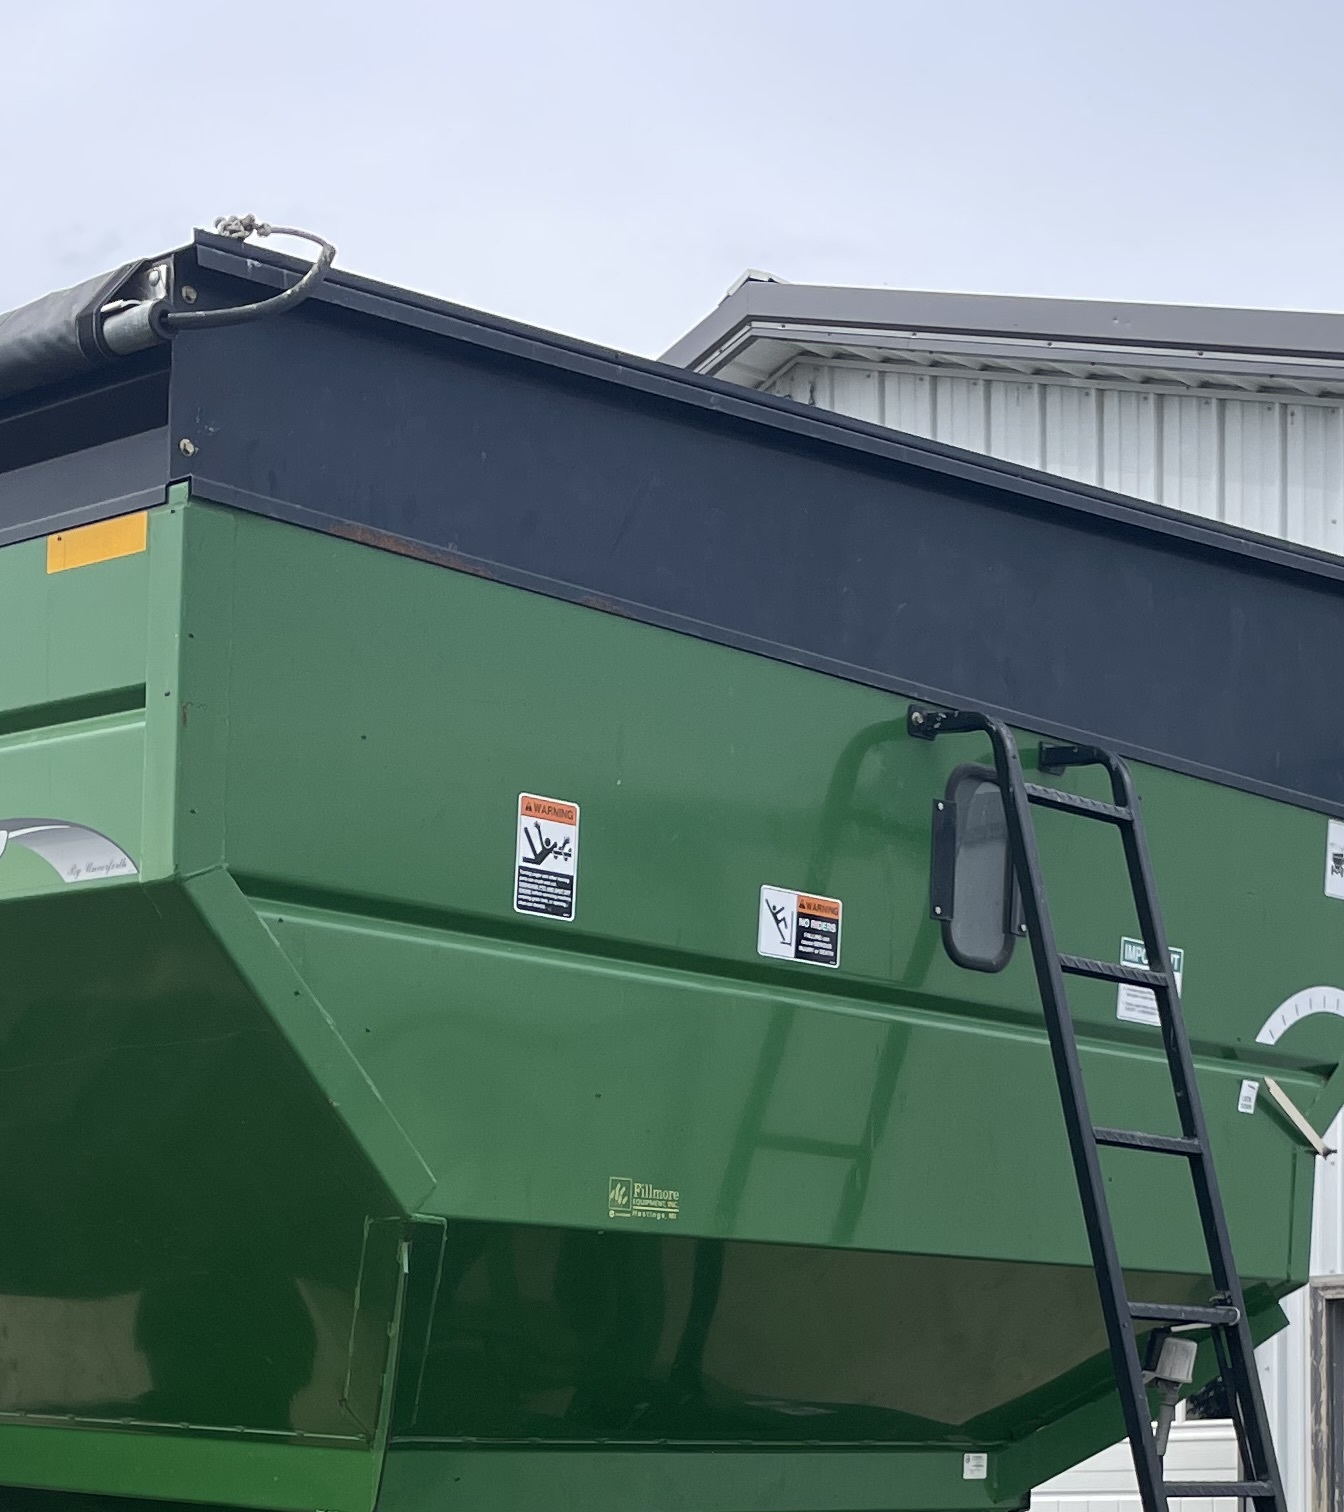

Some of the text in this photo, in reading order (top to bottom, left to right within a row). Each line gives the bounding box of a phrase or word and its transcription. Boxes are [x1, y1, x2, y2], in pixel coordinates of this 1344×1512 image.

[534, 802, 574, 820] WARNING
[805, 901, 839, 916] WARNING
[798, 917, 837, 933] NO RIDERS
[633, 1182, 680, 1201] Fillmore
